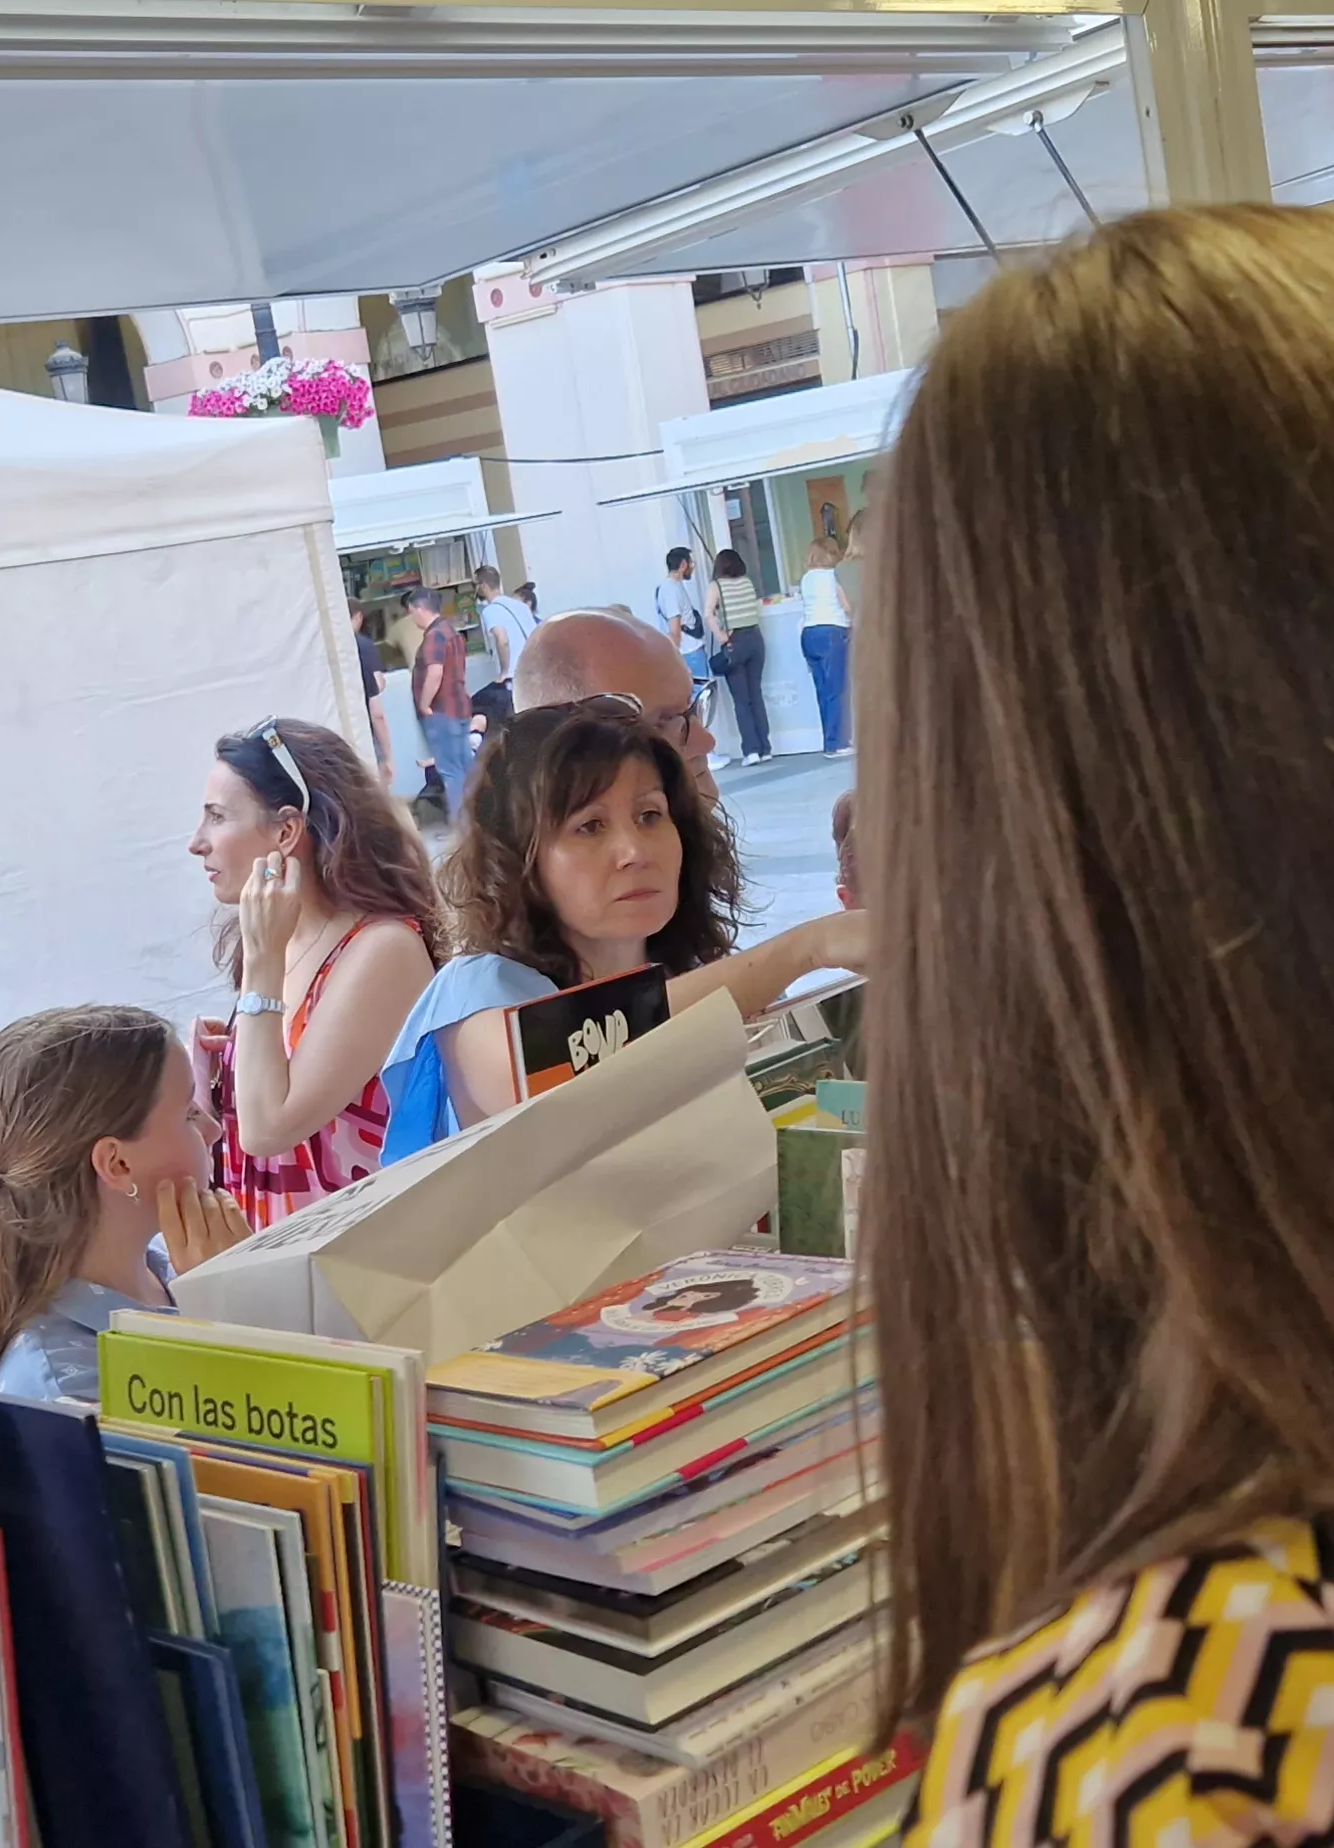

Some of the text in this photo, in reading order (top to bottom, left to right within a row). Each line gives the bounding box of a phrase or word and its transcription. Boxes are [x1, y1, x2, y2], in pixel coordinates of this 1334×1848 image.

[128, 1374, 338, 1450] Con las botas
